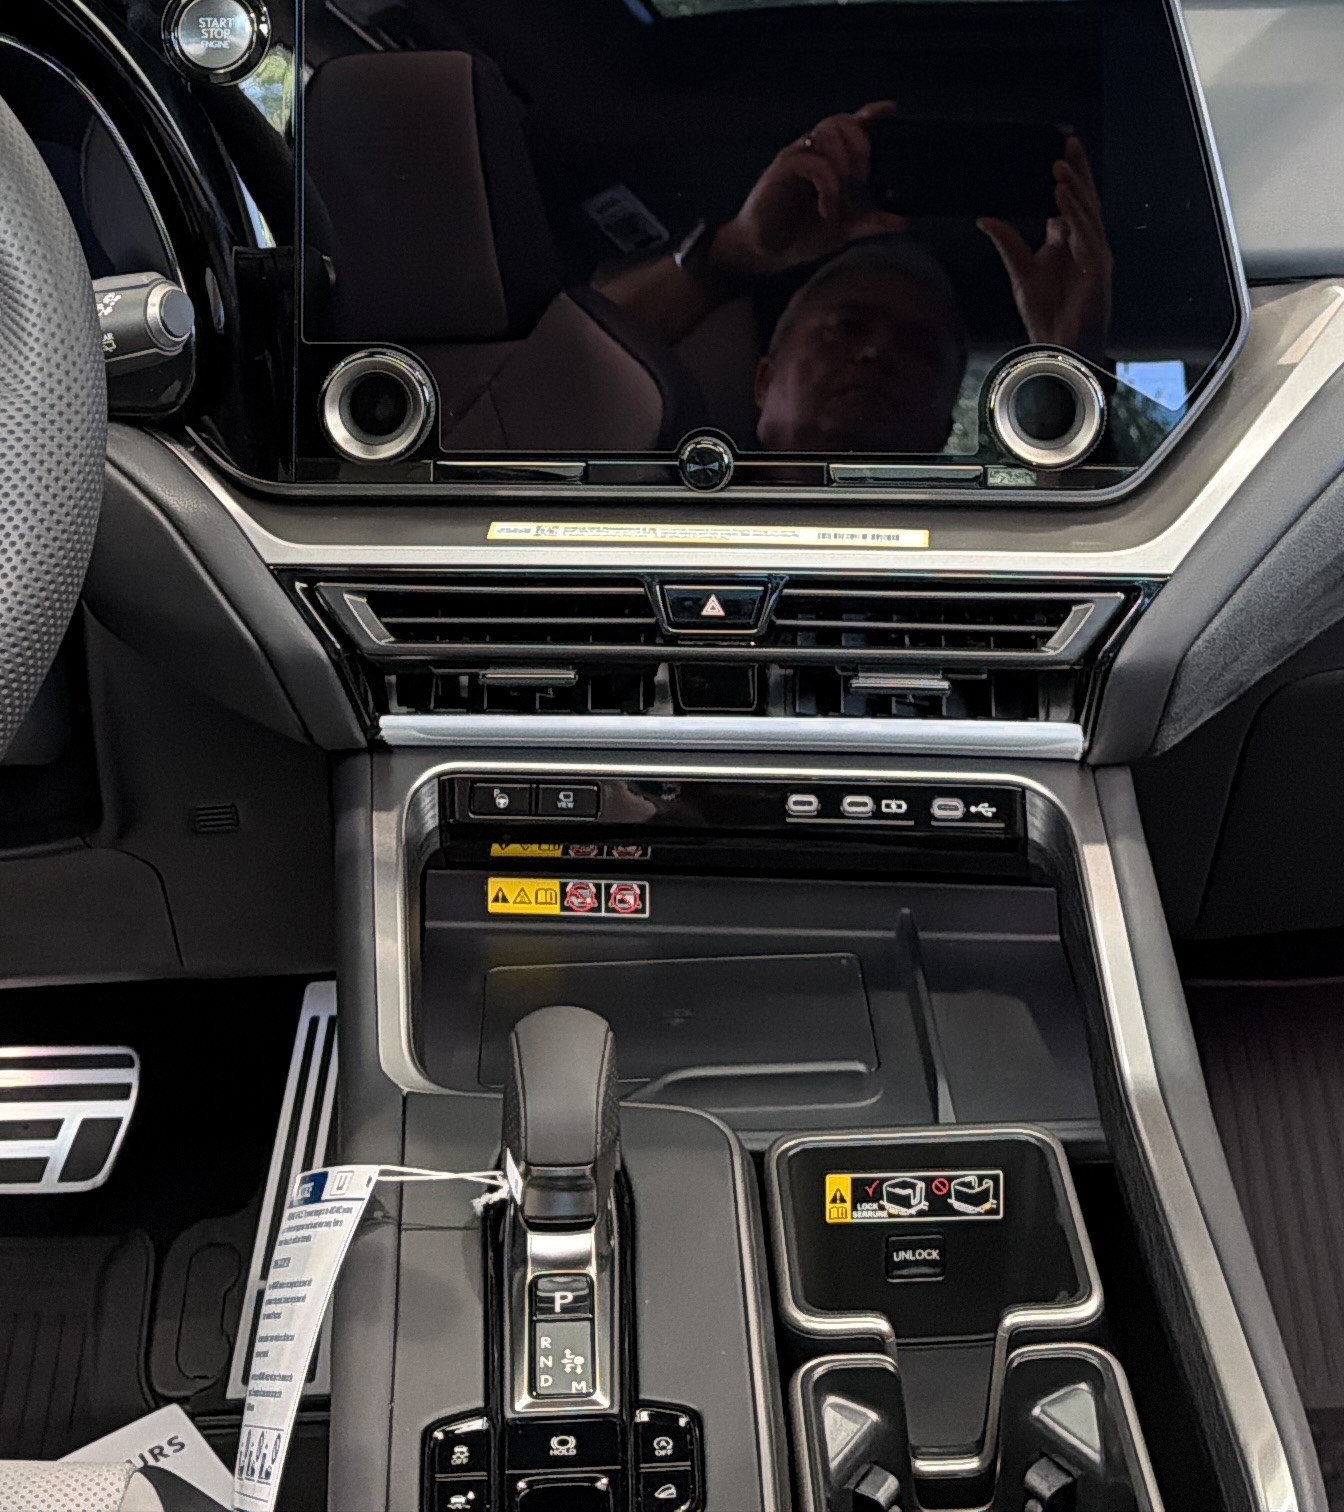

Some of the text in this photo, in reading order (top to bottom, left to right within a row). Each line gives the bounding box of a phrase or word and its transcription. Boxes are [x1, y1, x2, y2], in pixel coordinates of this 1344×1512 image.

[199, 17, 234, 28] START
[201, 28, 231, 38] STOP
[200, 40, 231, 48] ENGINE
[857, 1202, 879, 1211] LOCK
[852, 1209, 889, 1219] SERRURE
[892, 1249, 941, 1262] UNLOCK
[554, 1291, 574, 1313] P
[540, 1336, 552, 1349] R
[539, 1355, 553, 1368] N
[539, 1374, 553, 1387] D
[571, 1380, 587, 1393] M
[549, 1448, 577, 1457] HOLD
[654, 1448, 674, 1457] OFF
[450, 1455, 469, 1466] OFF
